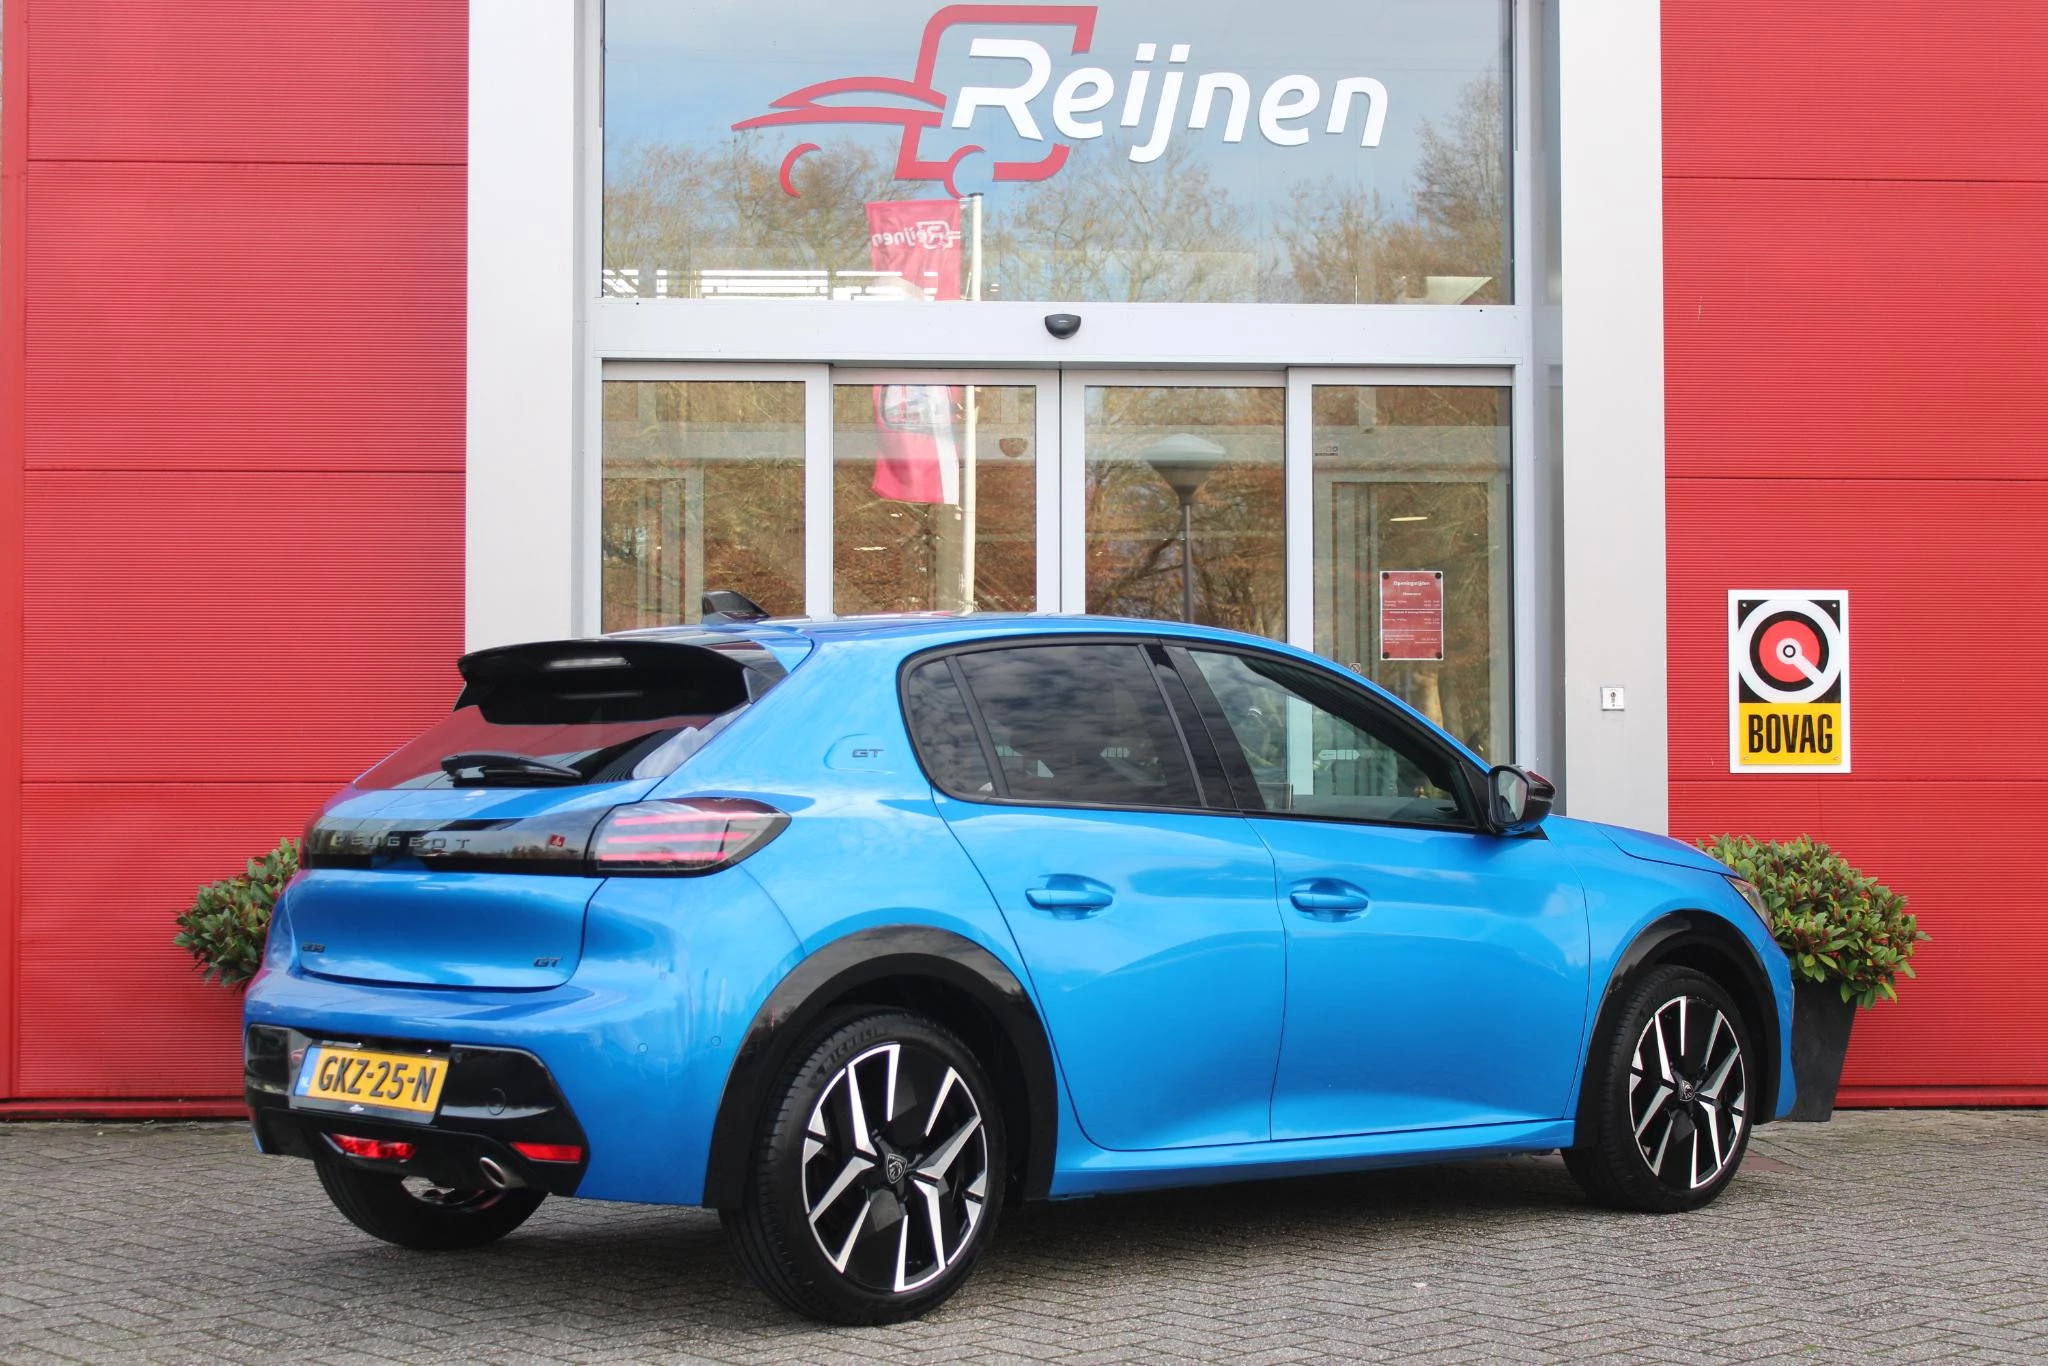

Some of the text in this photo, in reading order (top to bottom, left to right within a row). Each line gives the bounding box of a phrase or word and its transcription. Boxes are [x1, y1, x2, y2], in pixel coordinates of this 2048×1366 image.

[951, 38, 1389, 163] Reijnen
[1748, 713, 1833, 754] BOVAG
[852, 748, 884, 758] GT
[335, 835, 470, 849] PEUGEOT
[533, 956, 561, 968] GT
[318, 1055, 437, 1104] GKZ-25-N
